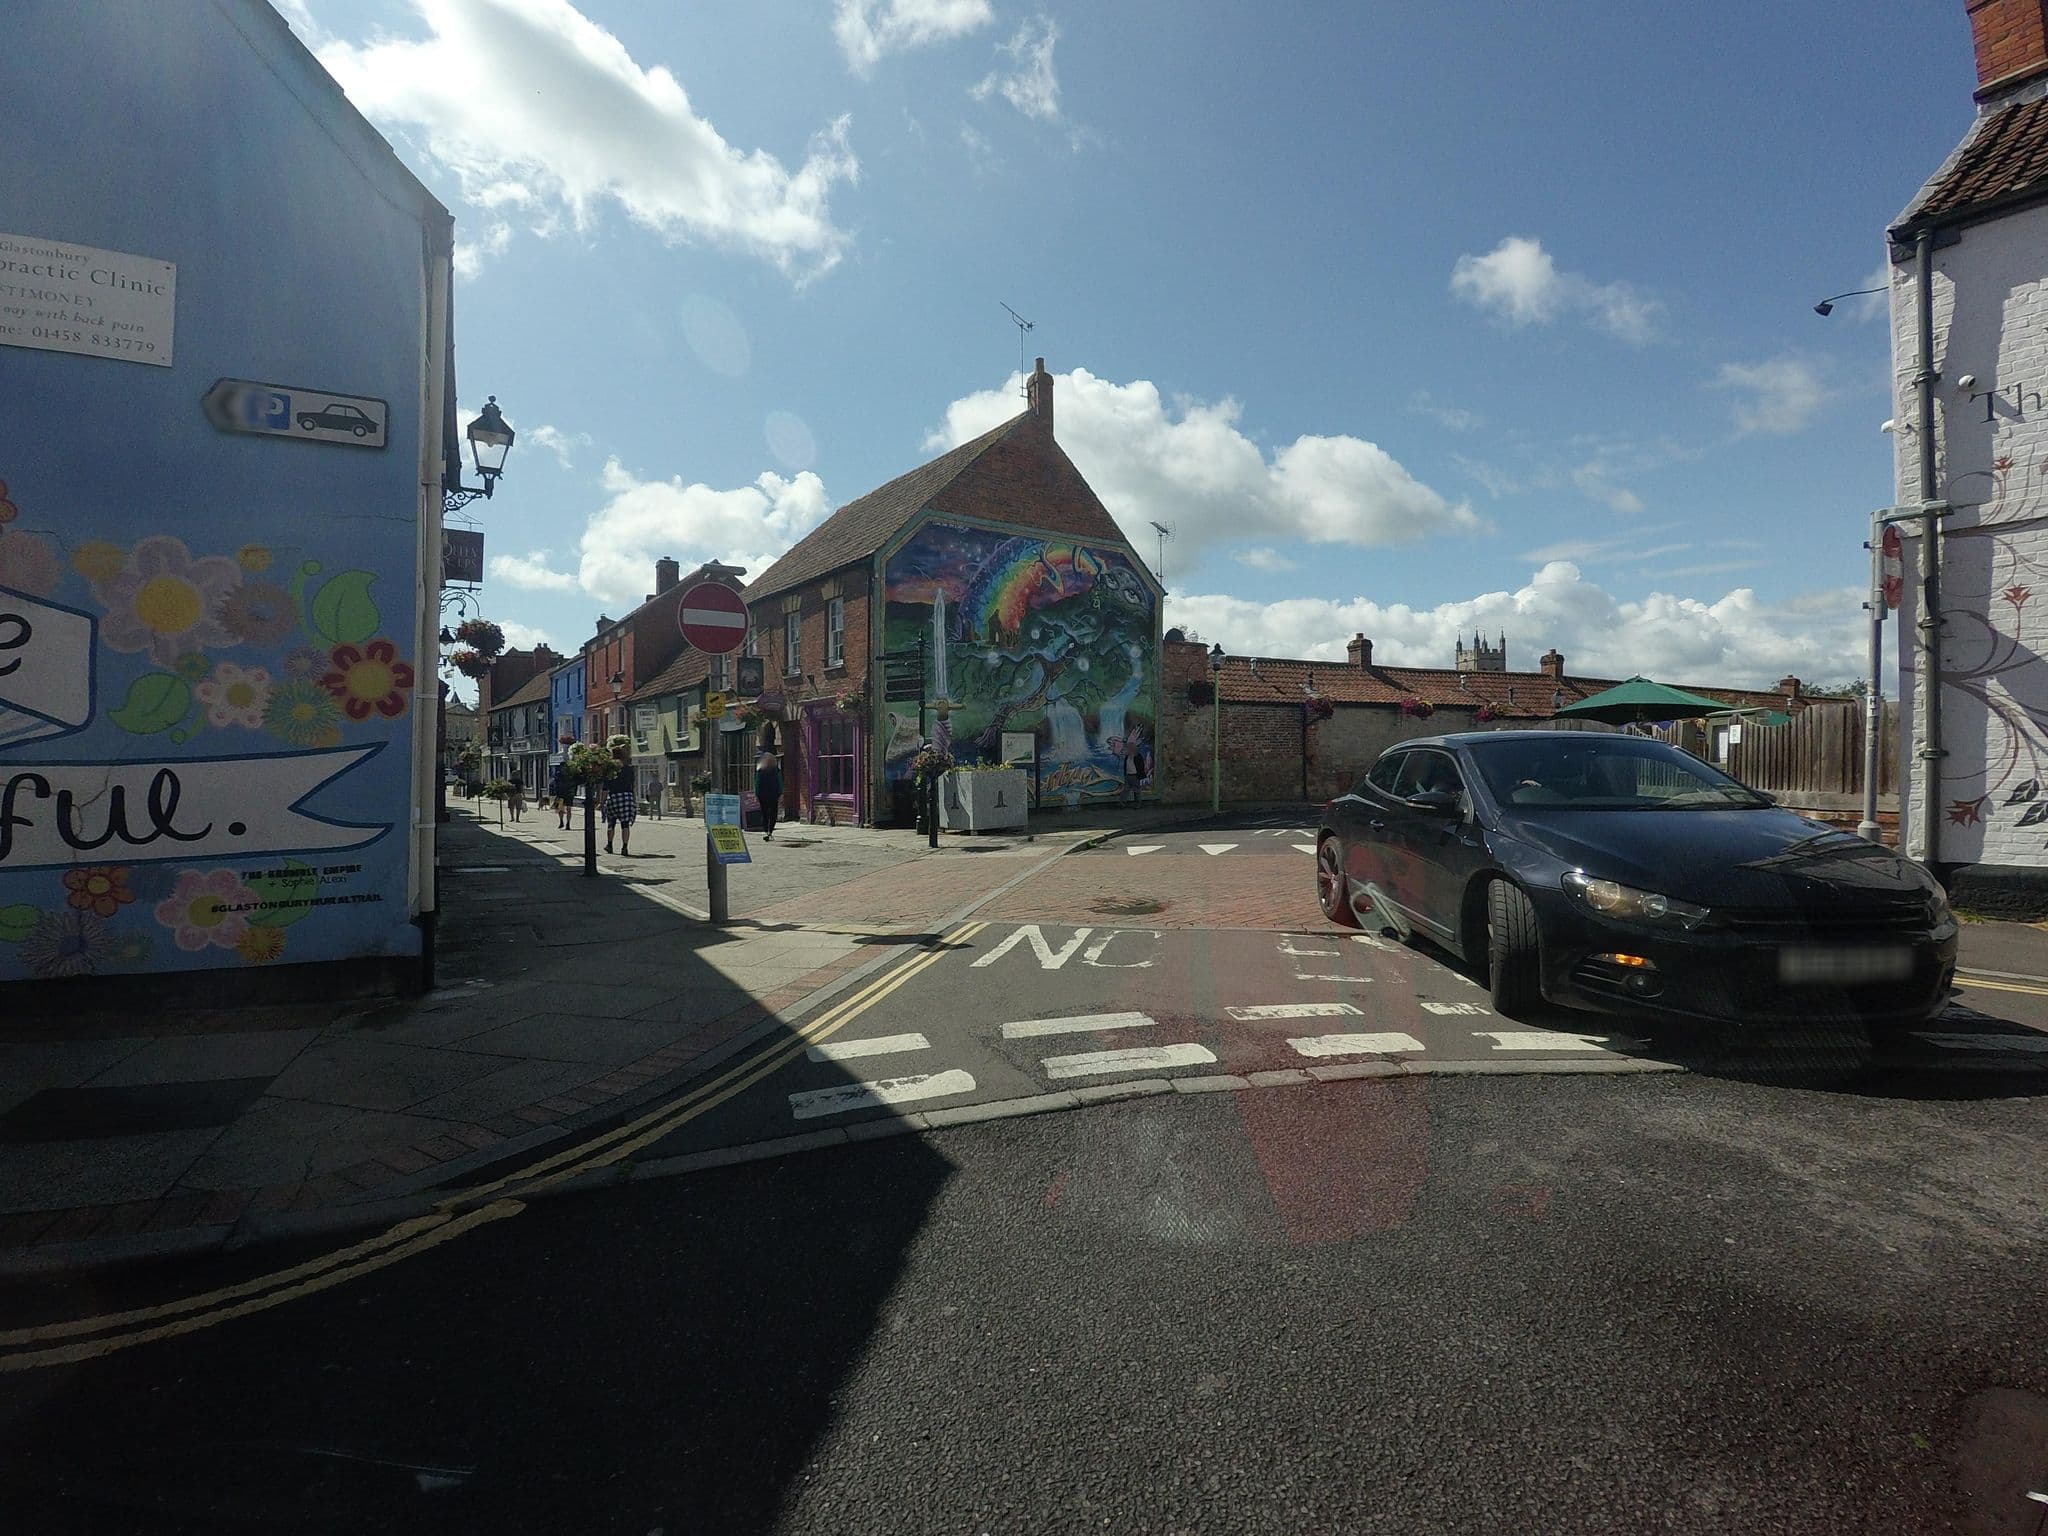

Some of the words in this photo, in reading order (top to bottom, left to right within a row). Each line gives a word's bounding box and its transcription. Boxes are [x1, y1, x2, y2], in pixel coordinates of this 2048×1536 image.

[0, 240, 89, 265] Glastonbury
[91, 269, 167, 297] Clinic
[35, 309, 67, 322] with
[74, 312, 105, 326] back
[112, 320, 145, 334] pain
[32, 326, 81, 342] 01458
[90, 335, 155, 352] 833779
